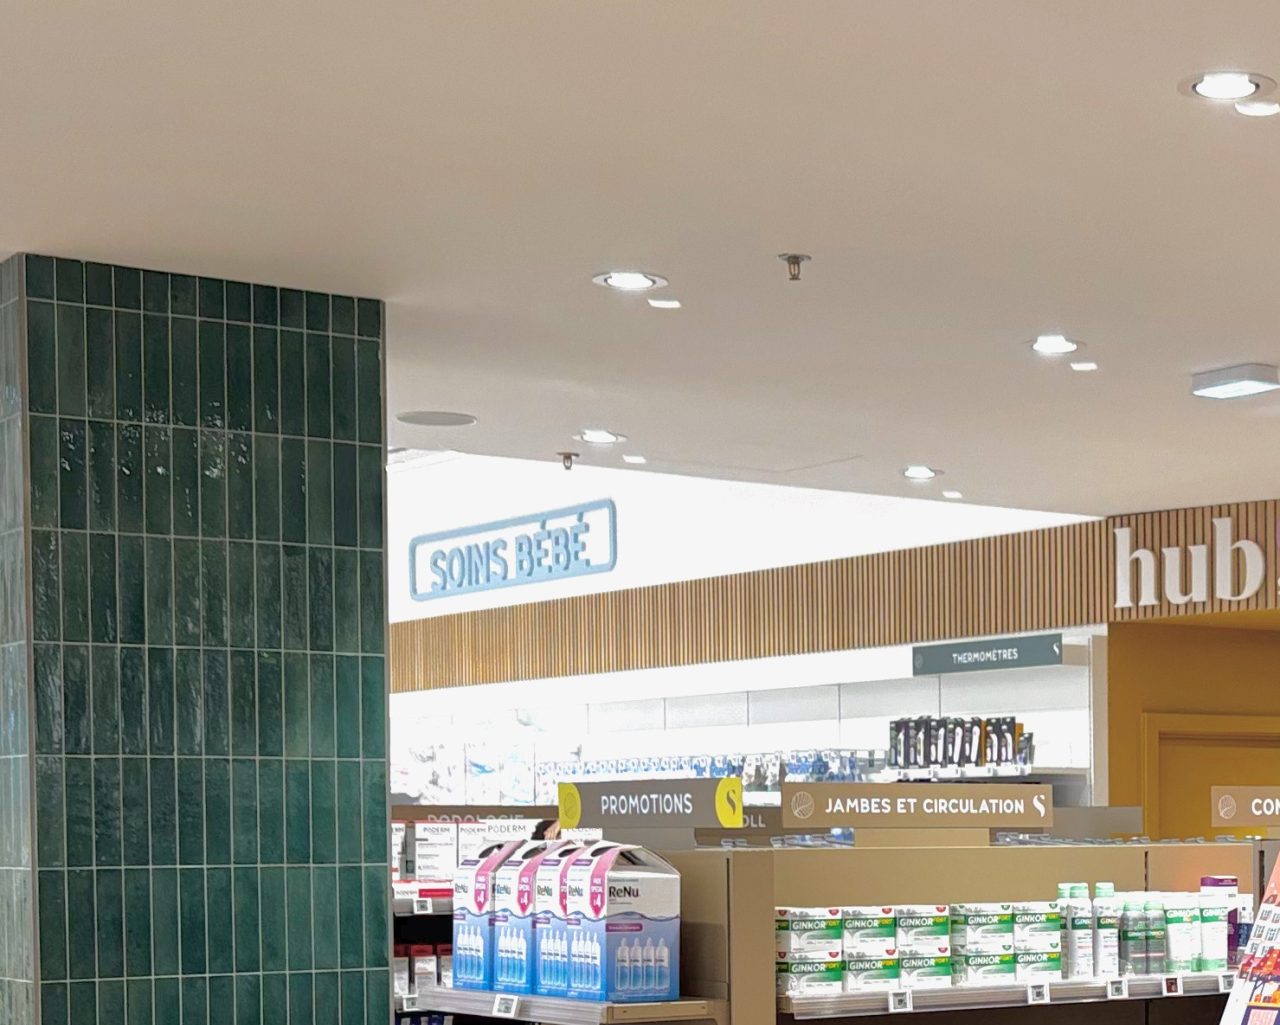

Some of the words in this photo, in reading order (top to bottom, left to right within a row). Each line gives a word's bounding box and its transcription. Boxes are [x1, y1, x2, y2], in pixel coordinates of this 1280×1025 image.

[429, 538, 508, 593] SOINS
[516, 512, 591, 580] BÉBÉ
[1113, 517, 1266, 609] hub
[952, 647, 1019, 664] THERMOMÈTRES
[601, 793, 693, 815] PROMOTIONS
[824, 797, 885, 816] JAMBES
[891, 797, 916, 816] ET
[922, 797, 1025, 816] CIRCULATION
[608, 885, 640, 898] ReNu
[899, 916, 934, 927] GINKOR
[967, 914, 1000, 925] GINKOR
[1015, 912, 1047, 923] GINKOR
[792, 919, 826, 931] GINKOR
[844, 918, 879, 929] GINKOR
[902, 958, 936, 969] GINKOR
[968, 955, 1000, 966] GINKOR
[1017, 953, 1049, 964] GINKOR
[791, 962, 826, 973] GINKOR
[849, 960, 883, 971] GINKOR
